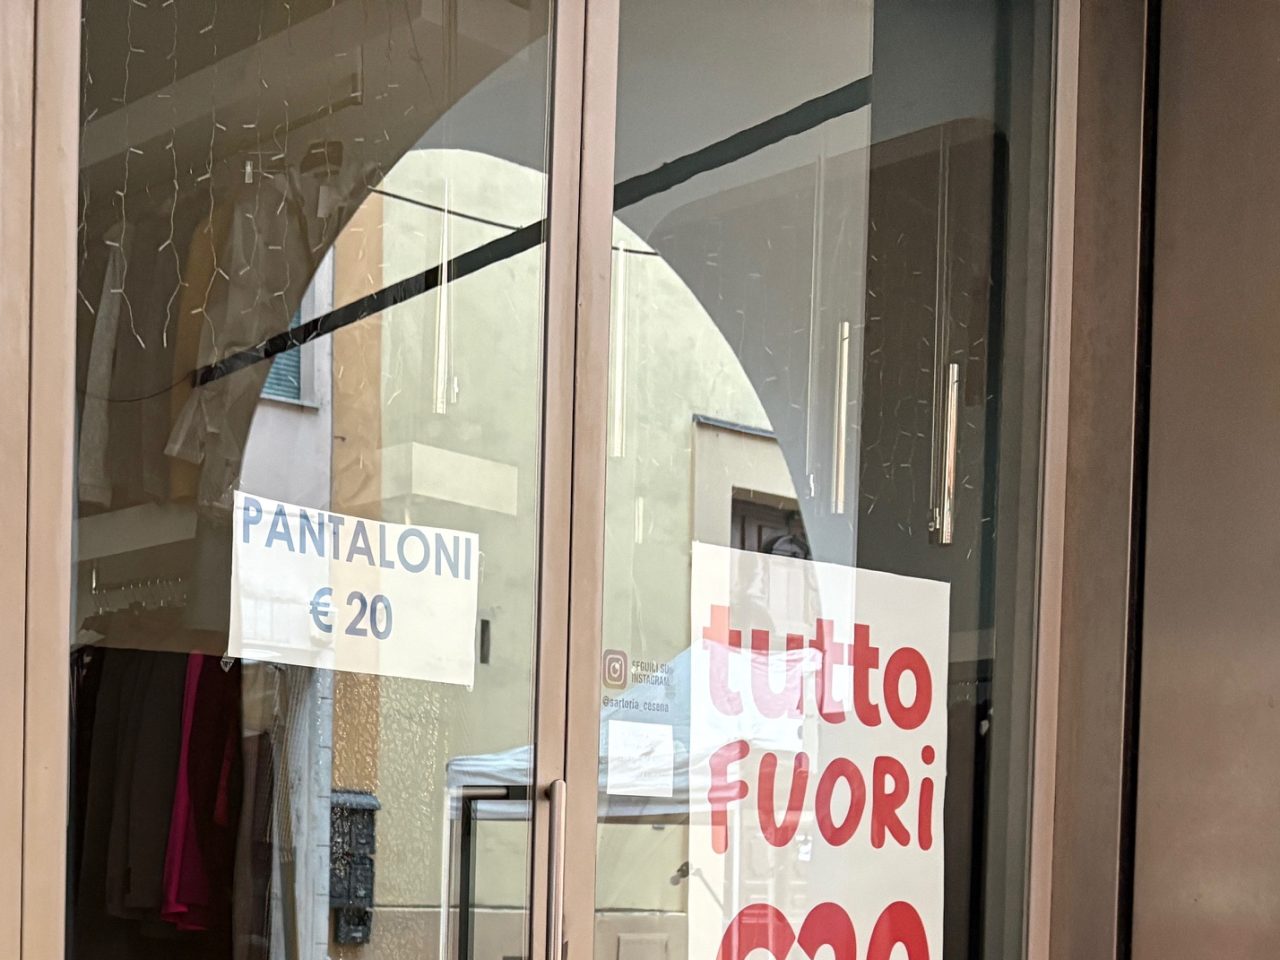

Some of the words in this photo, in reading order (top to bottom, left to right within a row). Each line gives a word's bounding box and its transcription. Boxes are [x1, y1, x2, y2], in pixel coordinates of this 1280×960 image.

[242, 496, 472, 580] PANTALONI
[309, 587, 334, 634] €
[344, 590, 393, 640] 20
[702, 604, 933, 731] tutto
